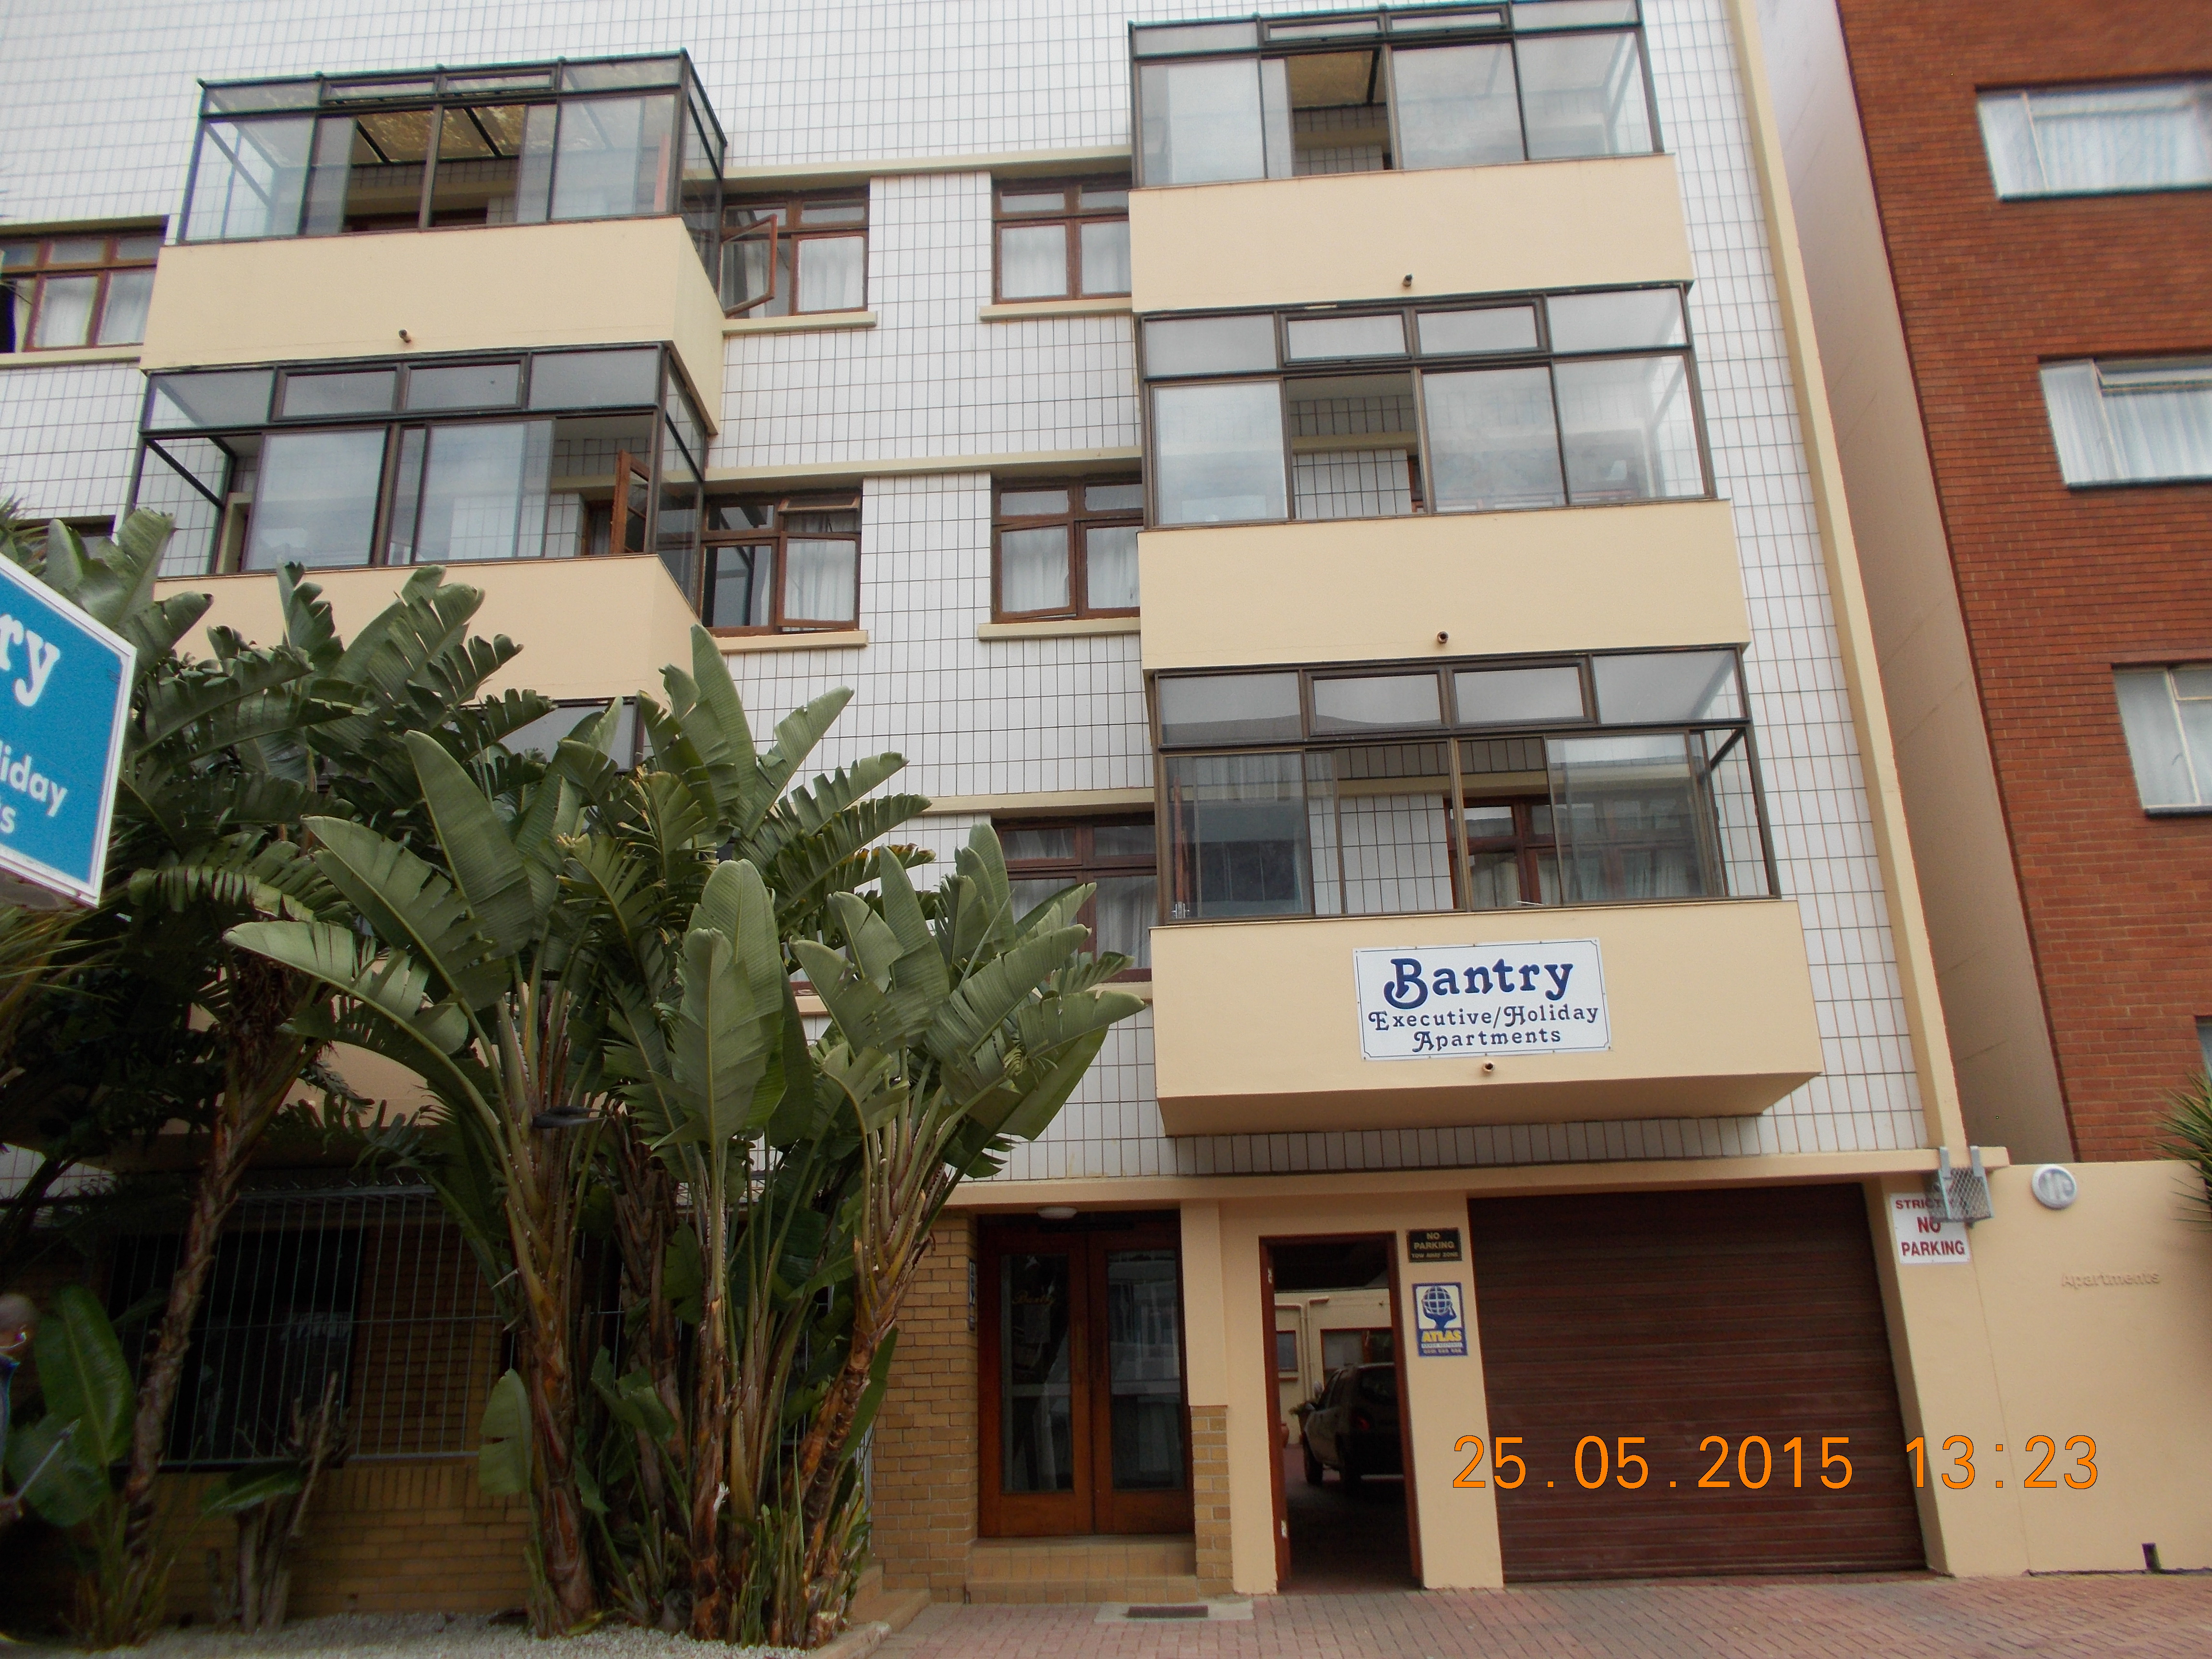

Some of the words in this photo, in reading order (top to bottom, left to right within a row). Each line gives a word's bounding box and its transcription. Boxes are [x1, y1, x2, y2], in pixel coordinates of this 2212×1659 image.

[1383, 957, 1574, 1010] Bantry
[1368, 1003, 1599, 1032] Executive/Holiday
[1412, 1030, 1561, 1053] Apartments
[1917, 1216, 1941, 1233] NO
[1426, 1232, 1441, 1240] NO
[1414, 1241, 1455, 1250] PARKING
[1901, 1239, 1965, 1256] PARKING
[2062, 1273, 2160, 1290] Apartments
[1421, 1329, 1462, 1343] ATLAS
